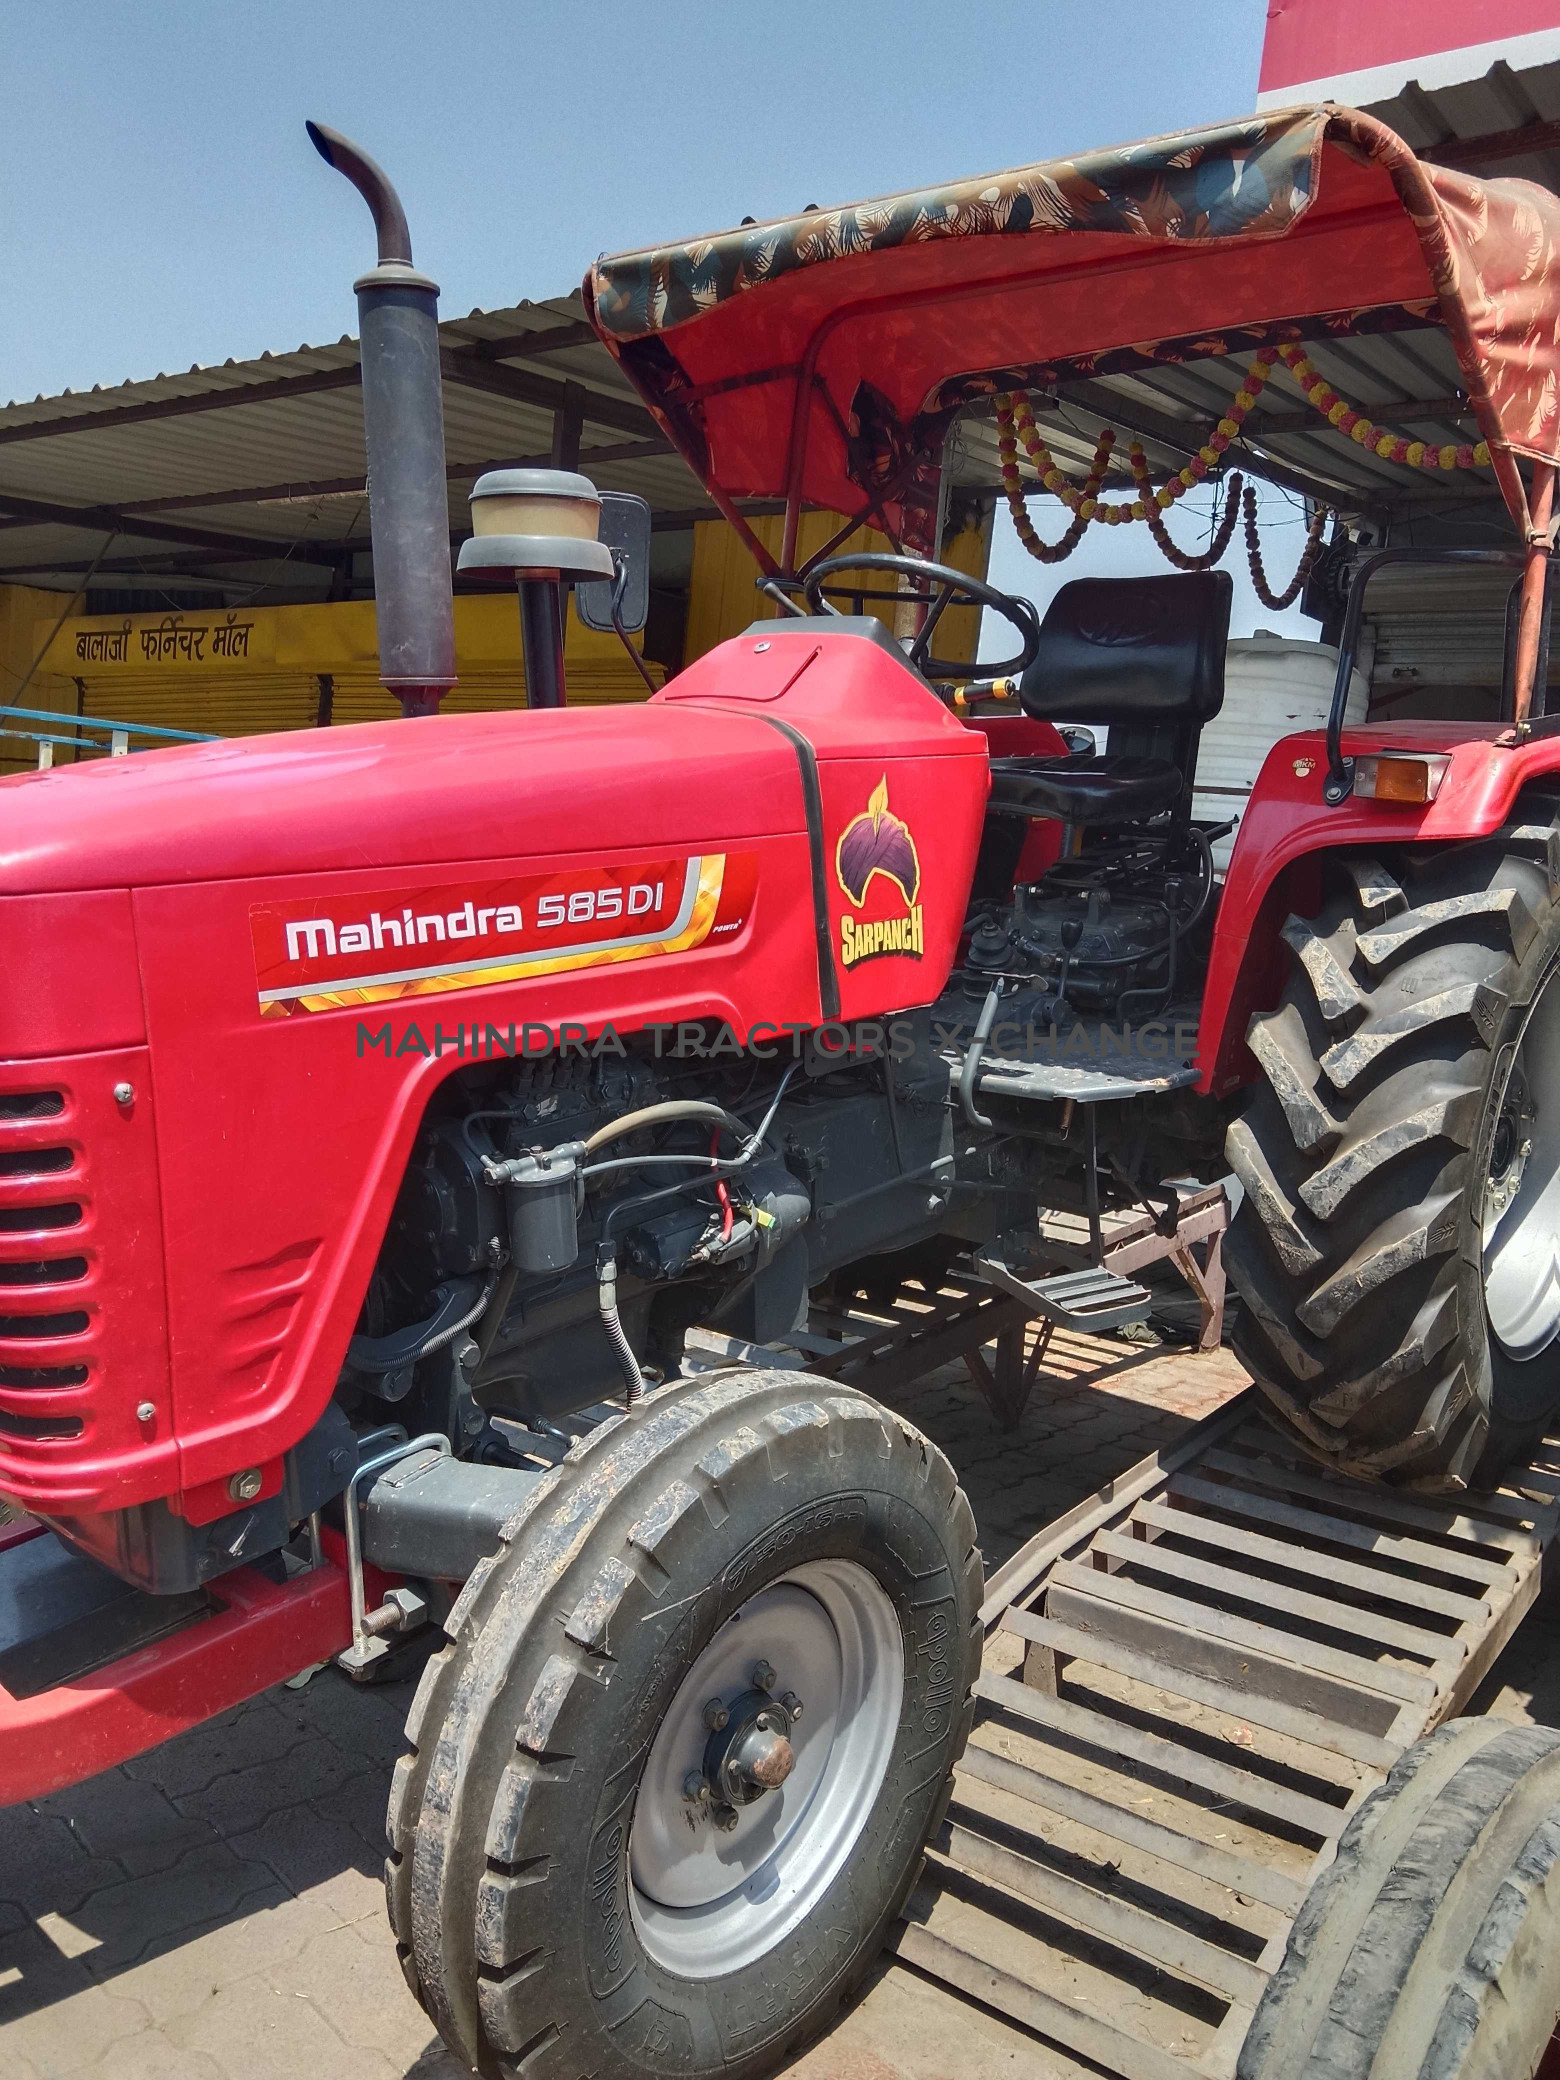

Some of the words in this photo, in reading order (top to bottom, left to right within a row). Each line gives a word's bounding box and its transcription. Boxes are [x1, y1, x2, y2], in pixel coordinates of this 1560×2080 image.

[76, 619, 132, 662] बालाजी
[140, 615, 209, 662] फर्निचर
[212, 613, 255, 657] मॉल
[286, 902, 523, 960] Mahindra
[841, 904, 924, 966] SARPANCH
[918, 1612, 954, 1733] apollo
[592, 1824, 625, 1972] apollo
